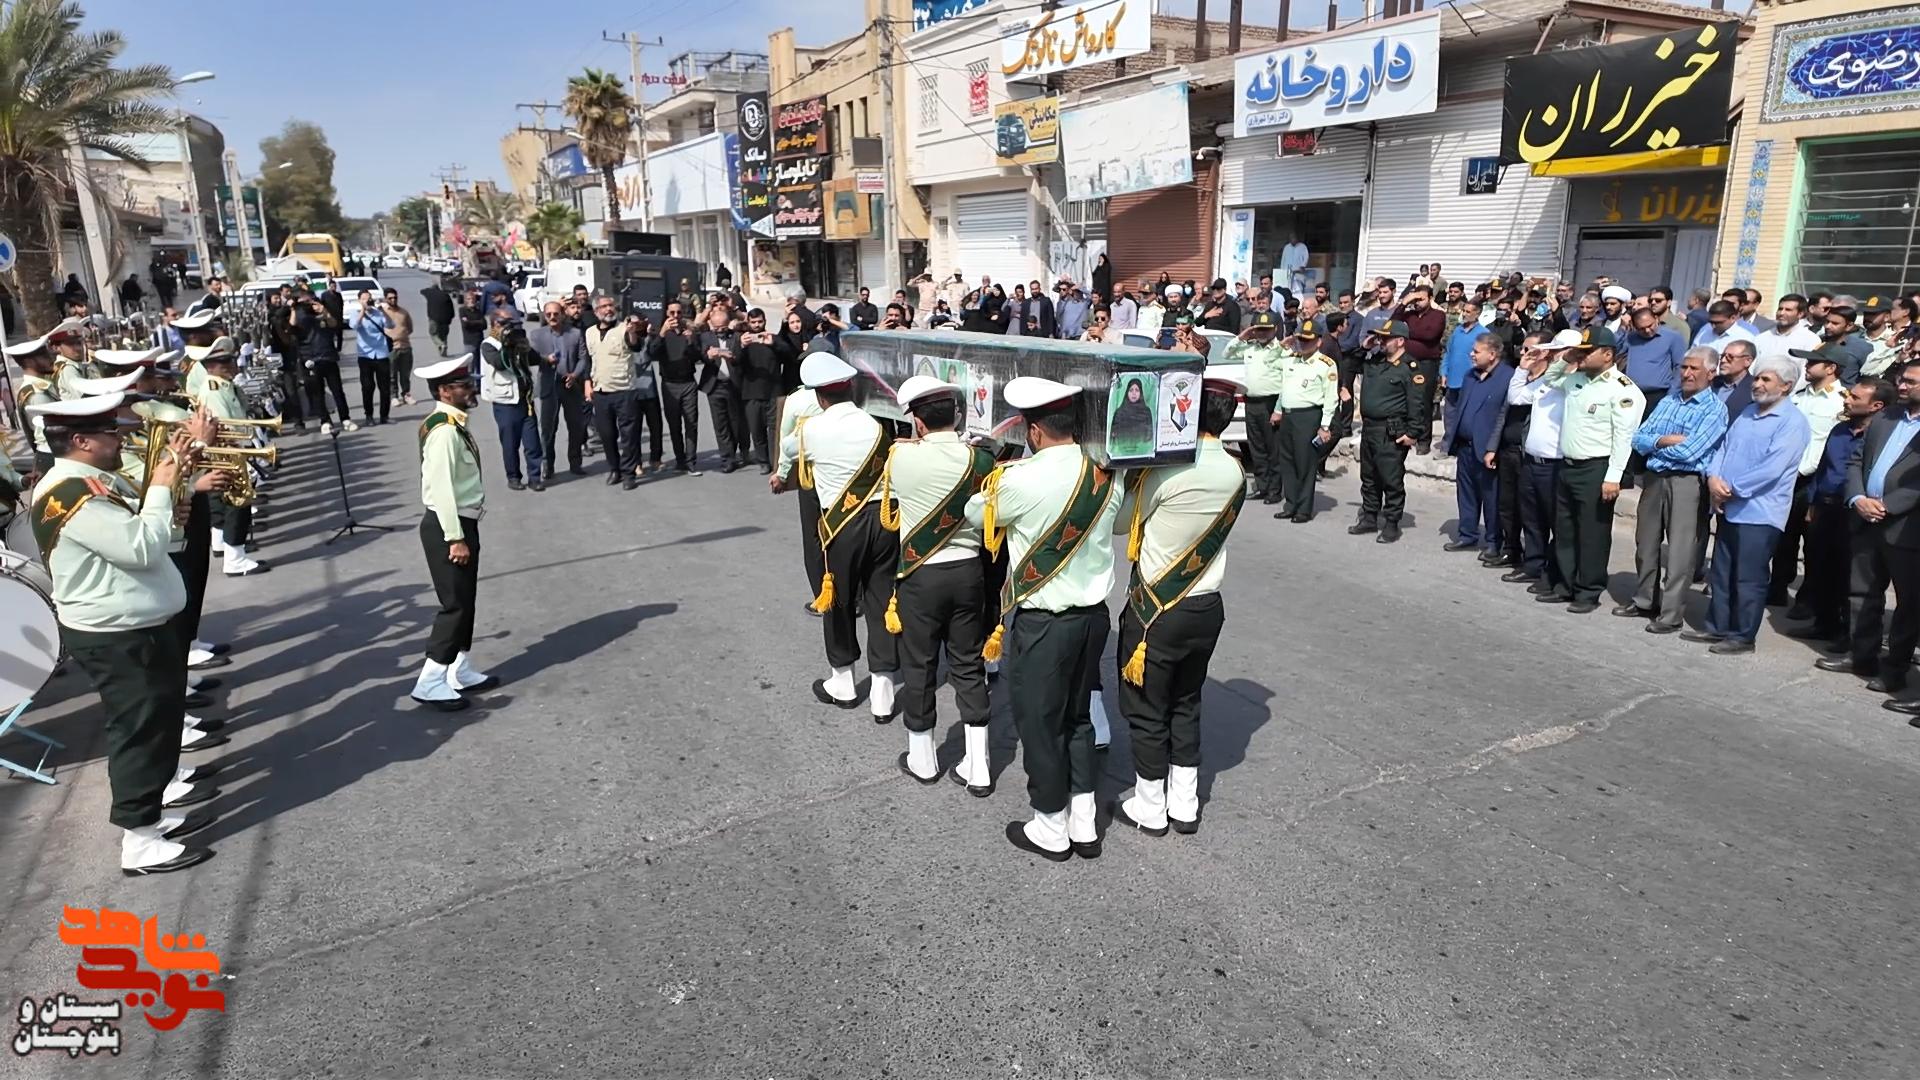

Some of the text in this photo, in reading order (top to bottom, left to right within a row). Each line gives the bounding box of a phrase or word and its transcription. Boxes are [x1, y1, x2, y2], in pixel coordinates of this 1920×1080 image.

[1060, 2, 1126, 62] کارواش
[1245, 36, 1414, 109] داروخانه
[1518, 24, 1720, 162] خیزران
[1639, 183, 1723, 224] یزران
[633, 301, 663, 310] POLICE
